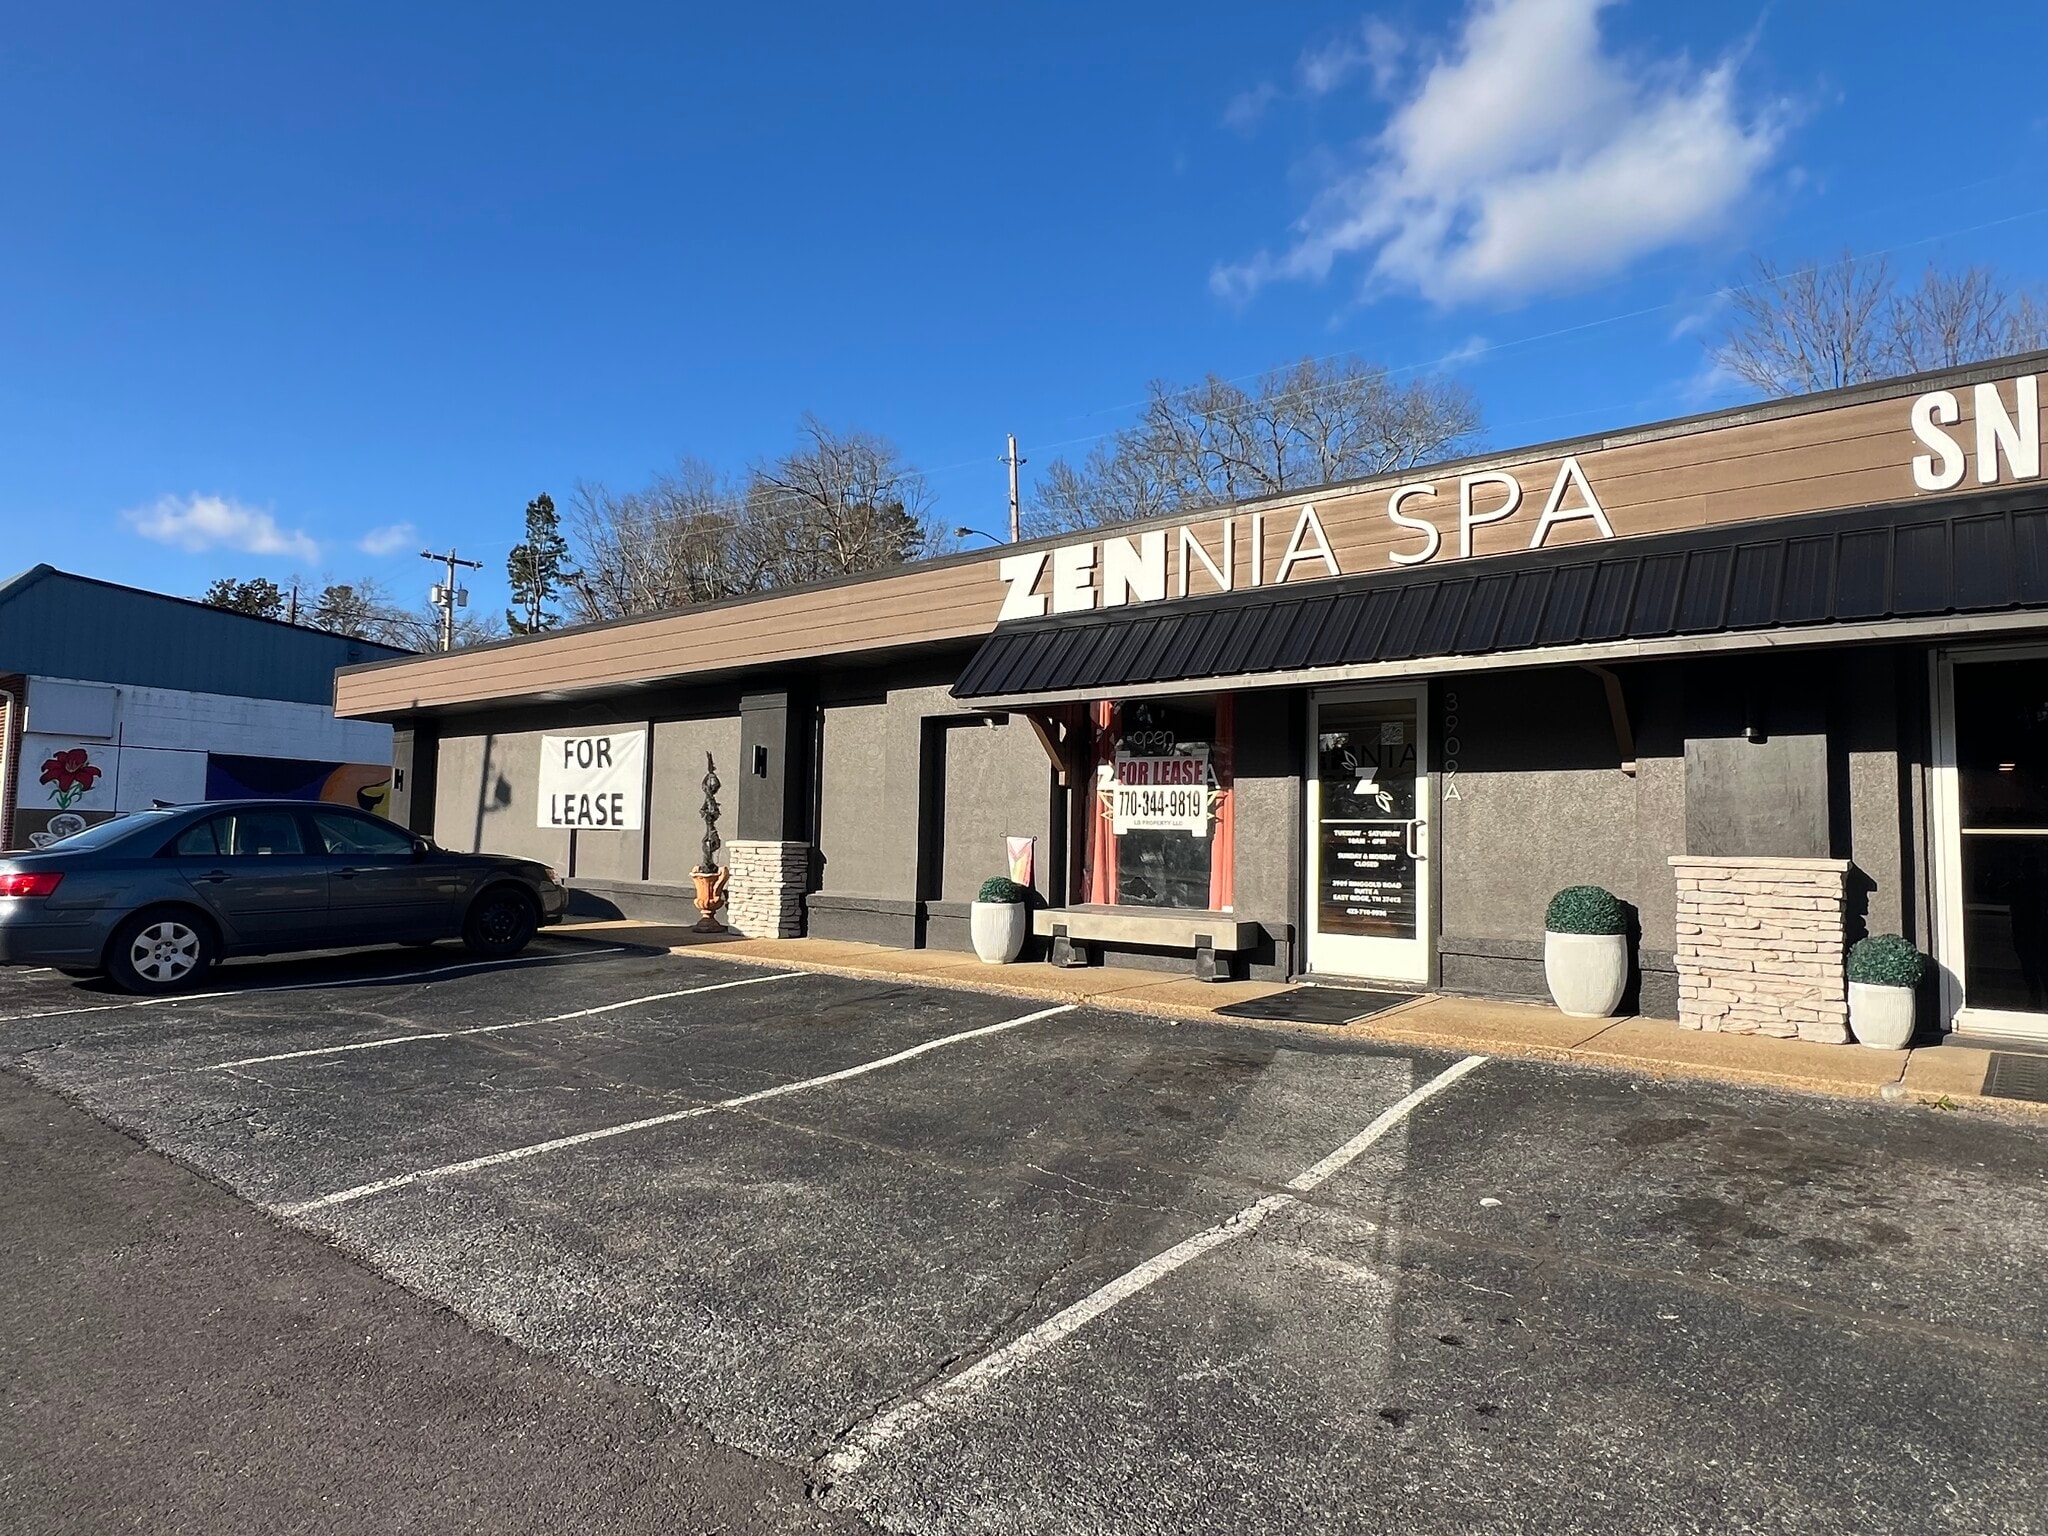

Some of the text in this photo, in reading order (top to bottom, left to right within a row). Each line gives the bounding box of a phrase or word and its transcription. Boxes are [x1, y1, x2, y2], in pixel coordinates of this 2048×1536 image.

[1911, 375, 2040, 491] SN
[997, 456, 1617, 623] ZENNIA SPA
[563, 736, 613, 770] FOR
[1133, 730, 1175, 750] open
[1118, 761, 1149, 785] FOR
[1153, 760, 1204, 785] LEASE
[1353, 766, 1380, 795] Z
[551, 793, 624, 827] LEASE
[1119, 790, 1201, 818] 770-344-9819
